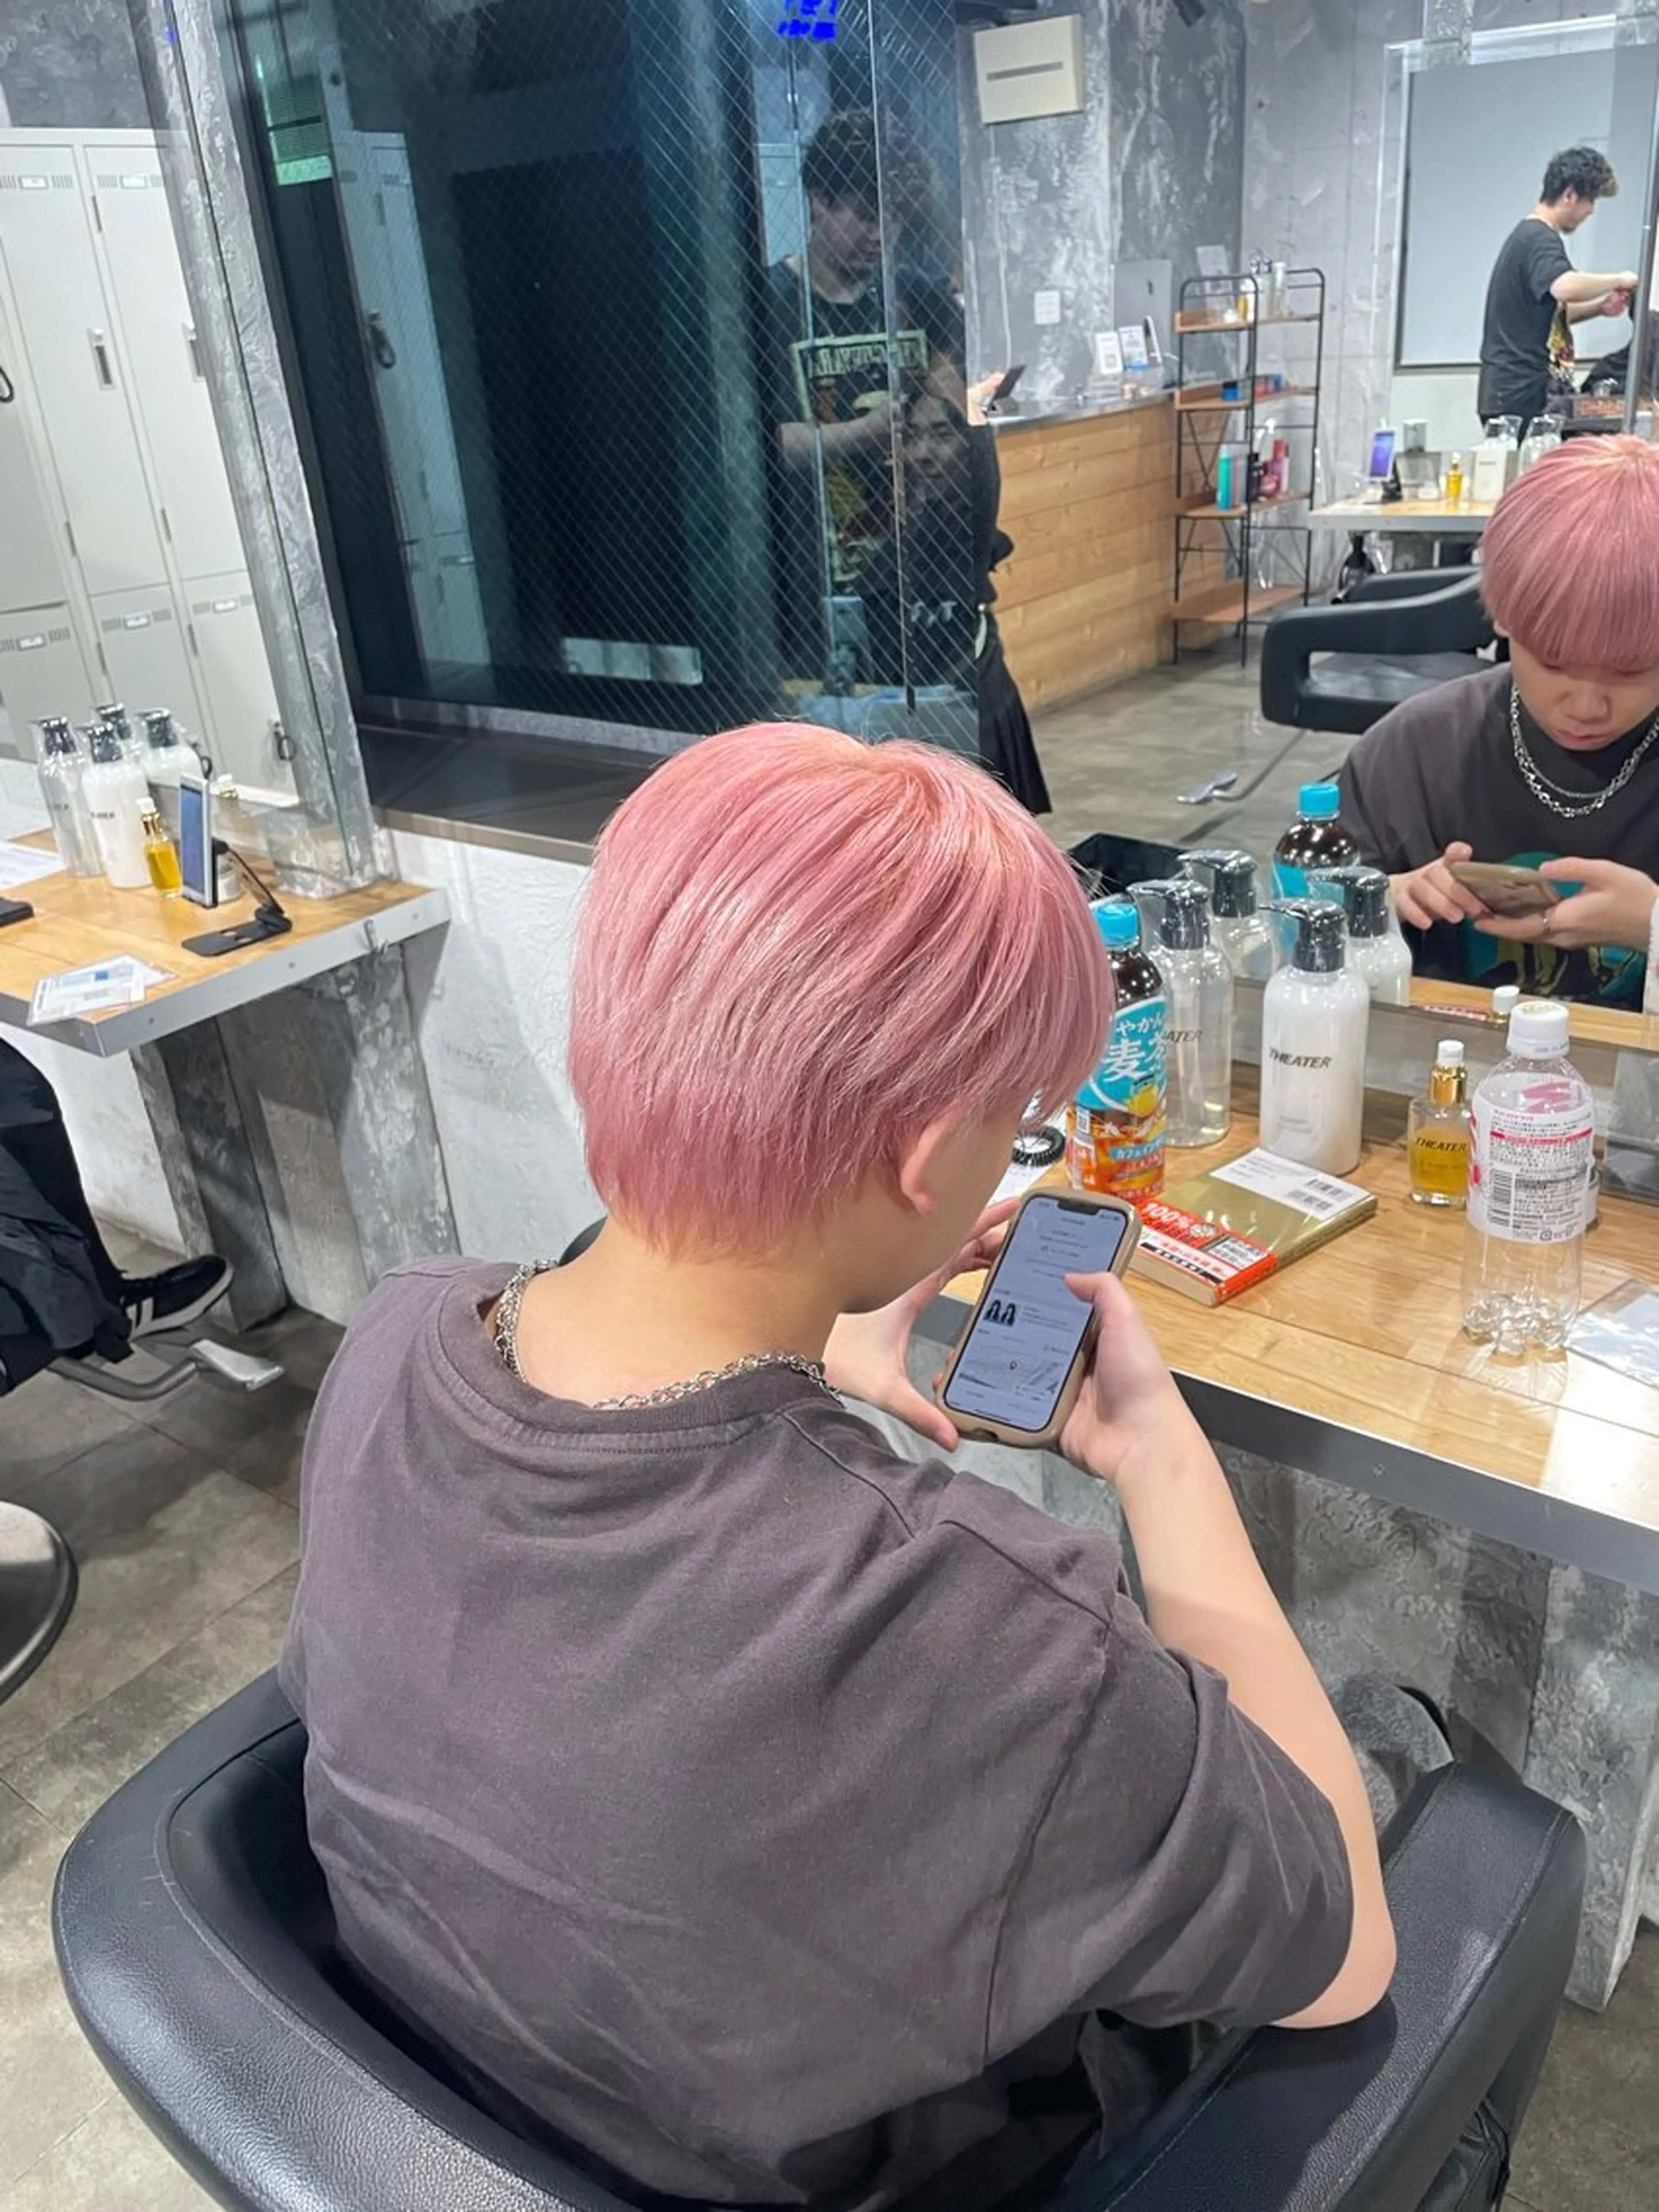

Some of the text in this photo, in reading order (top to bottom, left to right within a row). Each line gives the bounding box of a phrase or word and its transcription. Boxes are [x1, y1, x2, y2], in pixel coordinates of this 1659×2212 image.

[1162, 1029, 1203, 1043] ATER
[1269, 1046, 1331, 1069] THEATER
[1415, 1137, 1467, 1152] THEATER
